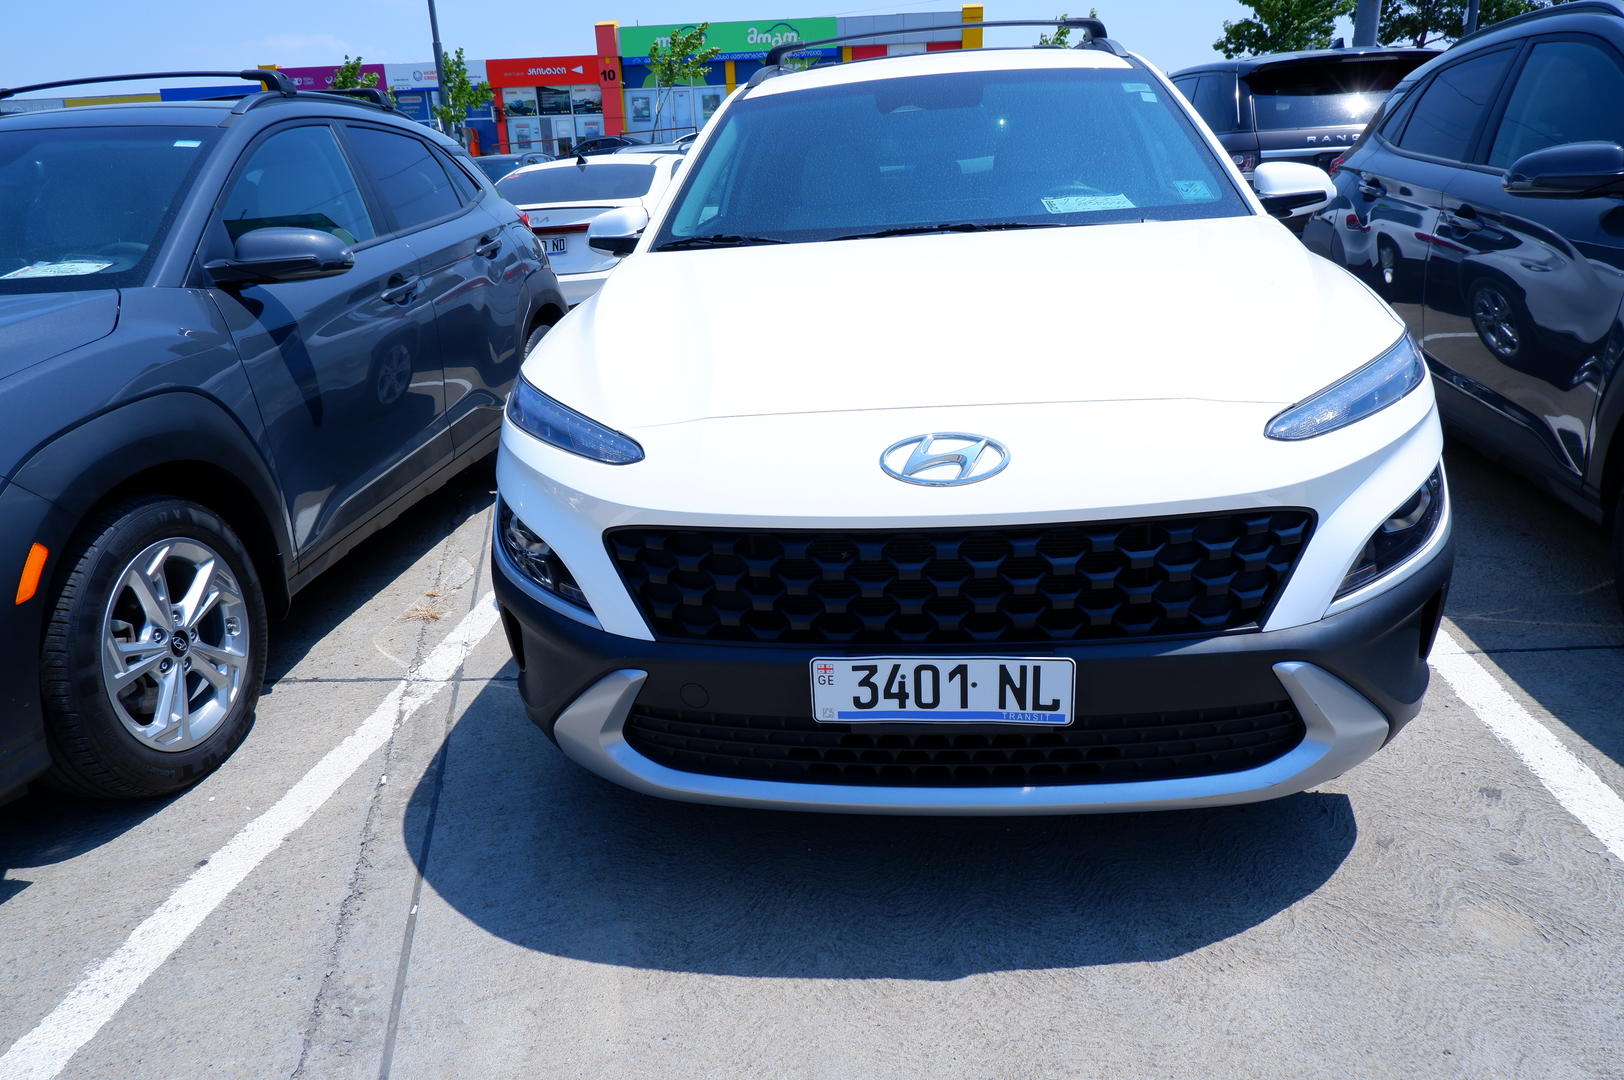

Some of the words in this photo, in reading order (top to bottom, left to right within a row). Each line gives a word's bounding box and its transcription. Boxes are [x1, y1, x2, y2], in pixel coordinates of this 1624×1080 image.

[601, 70, 616, 81] 10
[1306, 133, 1361, 143] RANG
[817, 674, 835, 686] GE
[851, 663, 969, 710] 3401
[998, 664, 1061, 712] NL
[1002, 712, 1051, 721] TRANSIT
